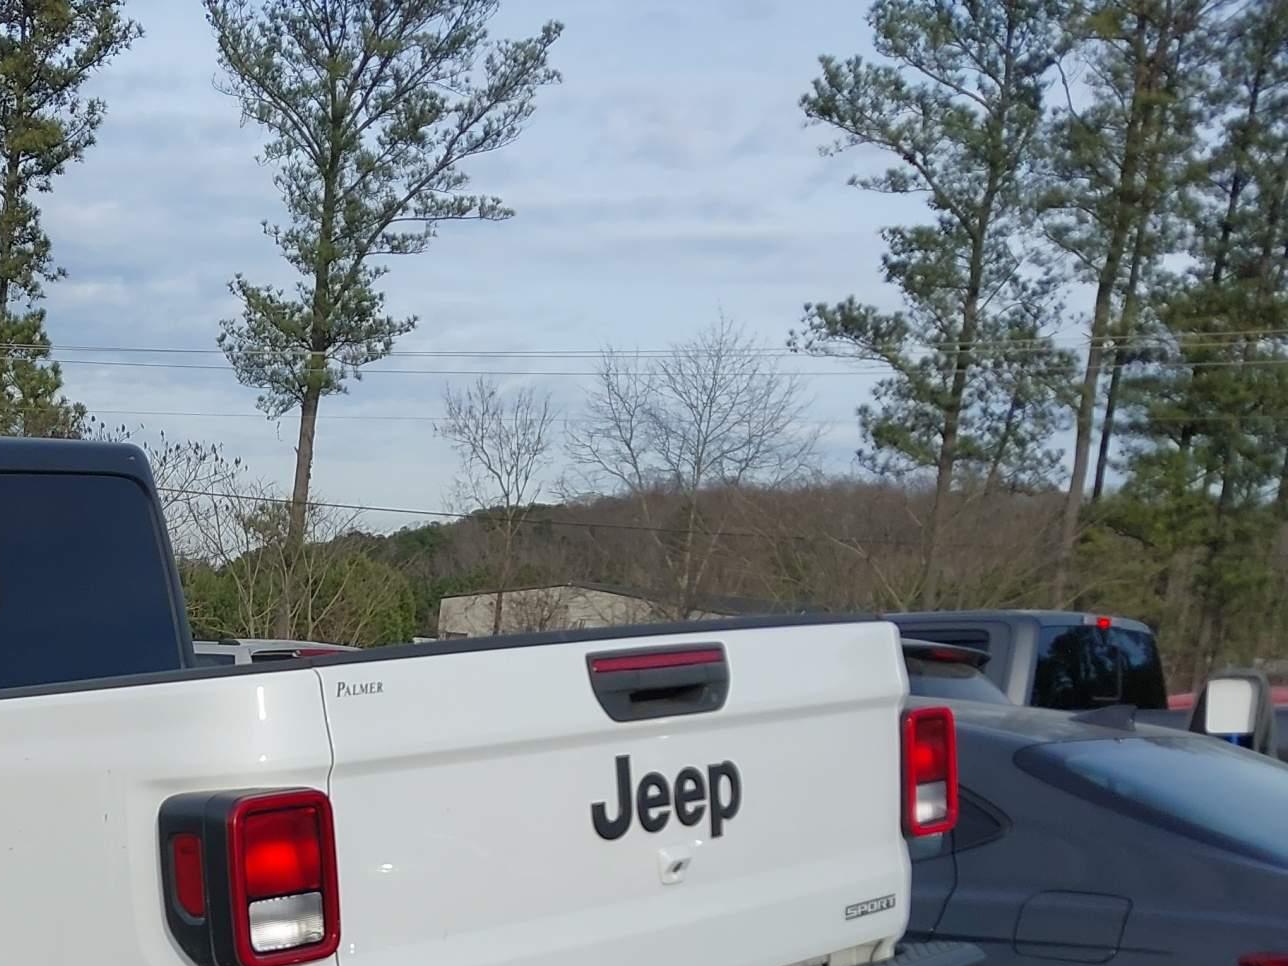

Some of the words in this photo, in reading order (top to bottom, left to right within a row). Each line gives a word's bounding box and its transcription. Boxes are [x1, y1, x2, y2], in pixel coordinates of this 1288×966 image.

[336, 680, 384, 698] PALMER
[591, 754, 742, 841] Jeep
[844, 893, 896, 921] SPORT
